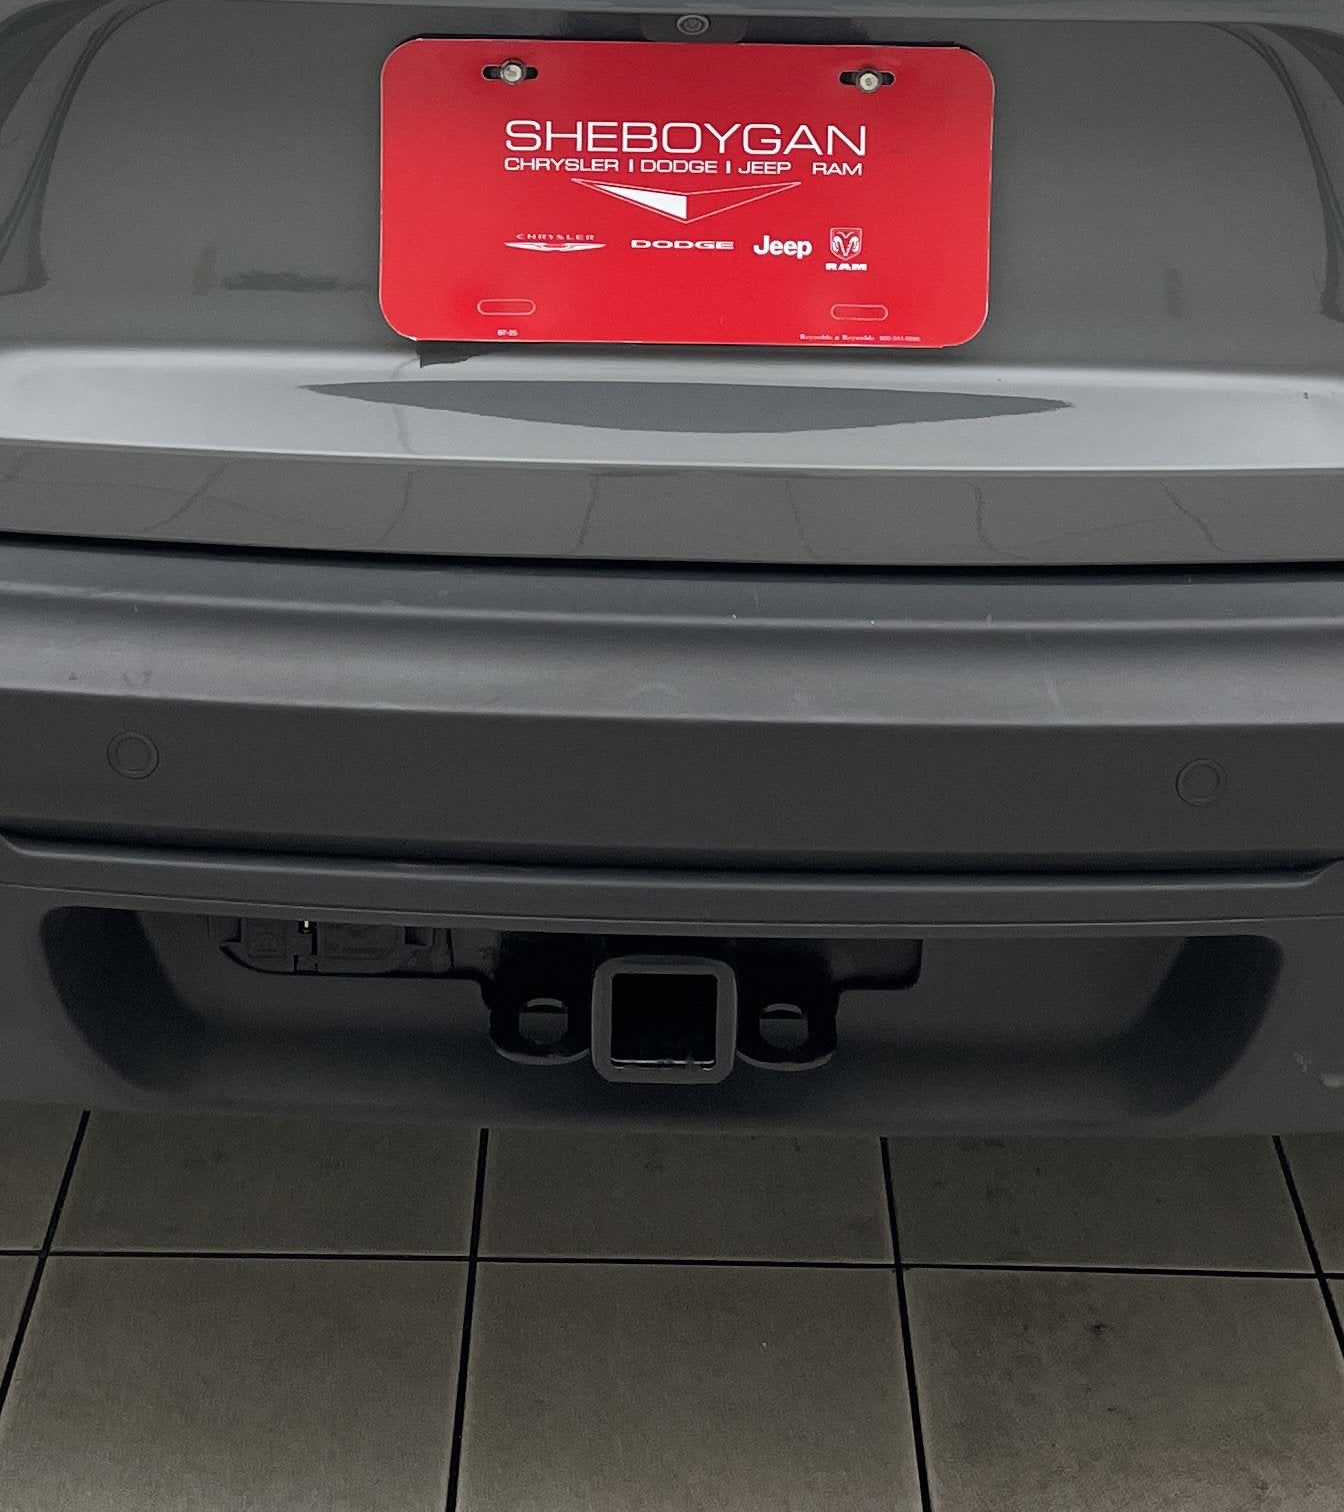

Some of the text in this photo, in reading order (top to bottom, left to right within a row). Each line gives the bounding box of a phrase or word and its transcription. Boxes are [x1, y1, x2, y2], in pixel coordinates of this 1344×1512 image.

[505, 119, 867, 157] SHEBOYGAN
[504, 157, 620, 173] CHRYSLER
[640, 159, 719, 174] DODGE
[738, 160, 792, 175] JEEP
[812, 162, 863, 176] RAM
[516, 232, 868, 271] CHRYSLER DODGE Jeep RAM
